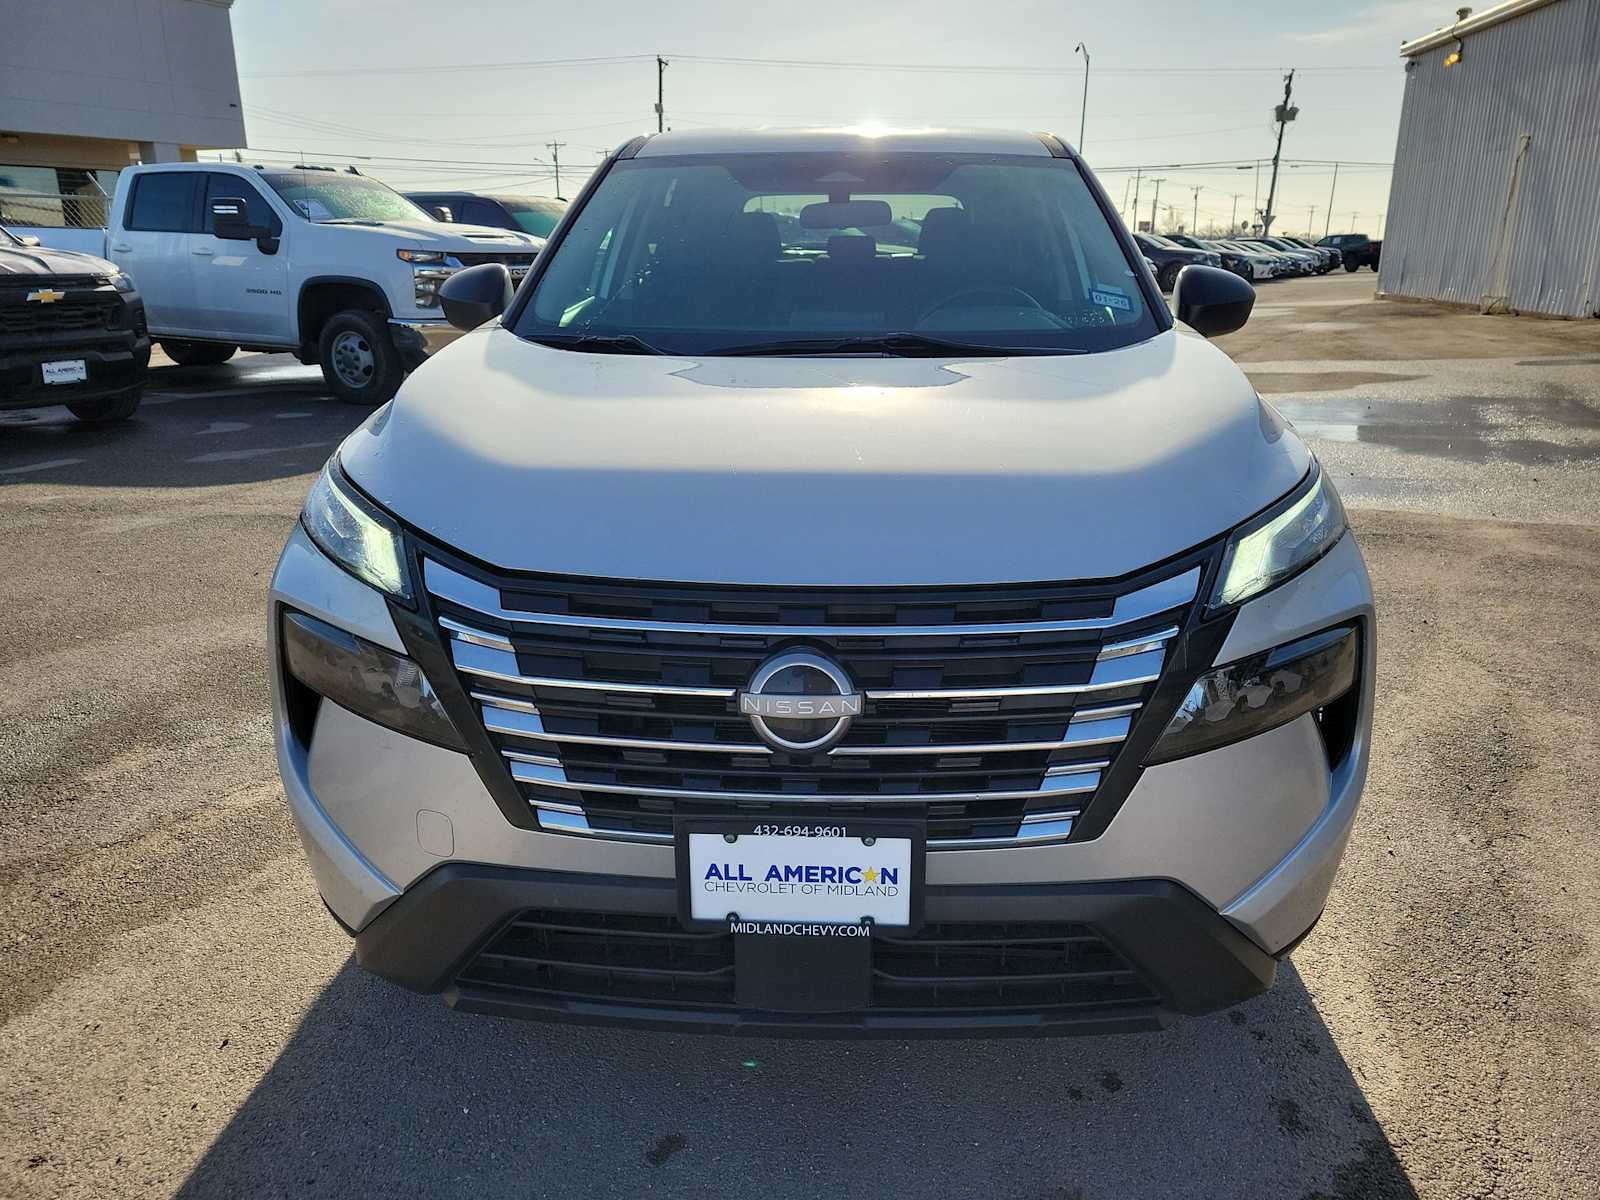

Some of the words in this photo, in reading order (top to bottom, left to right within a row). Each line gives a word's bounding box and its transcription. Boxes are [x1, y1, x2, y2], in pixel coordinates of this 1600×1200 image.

[744, 696, 858, 715] NISSAN
[753, 825, 847, 838] 432-694-9601
[704, 863, 753, 881] ALL
[704, 881, 796, 895] CHEVROLET
[801, 883, 824, 895] OF
[827, 884, 899, 897] MIDLAND
[730, 922, 870, 937] MIDLANDCHEVY.COM
